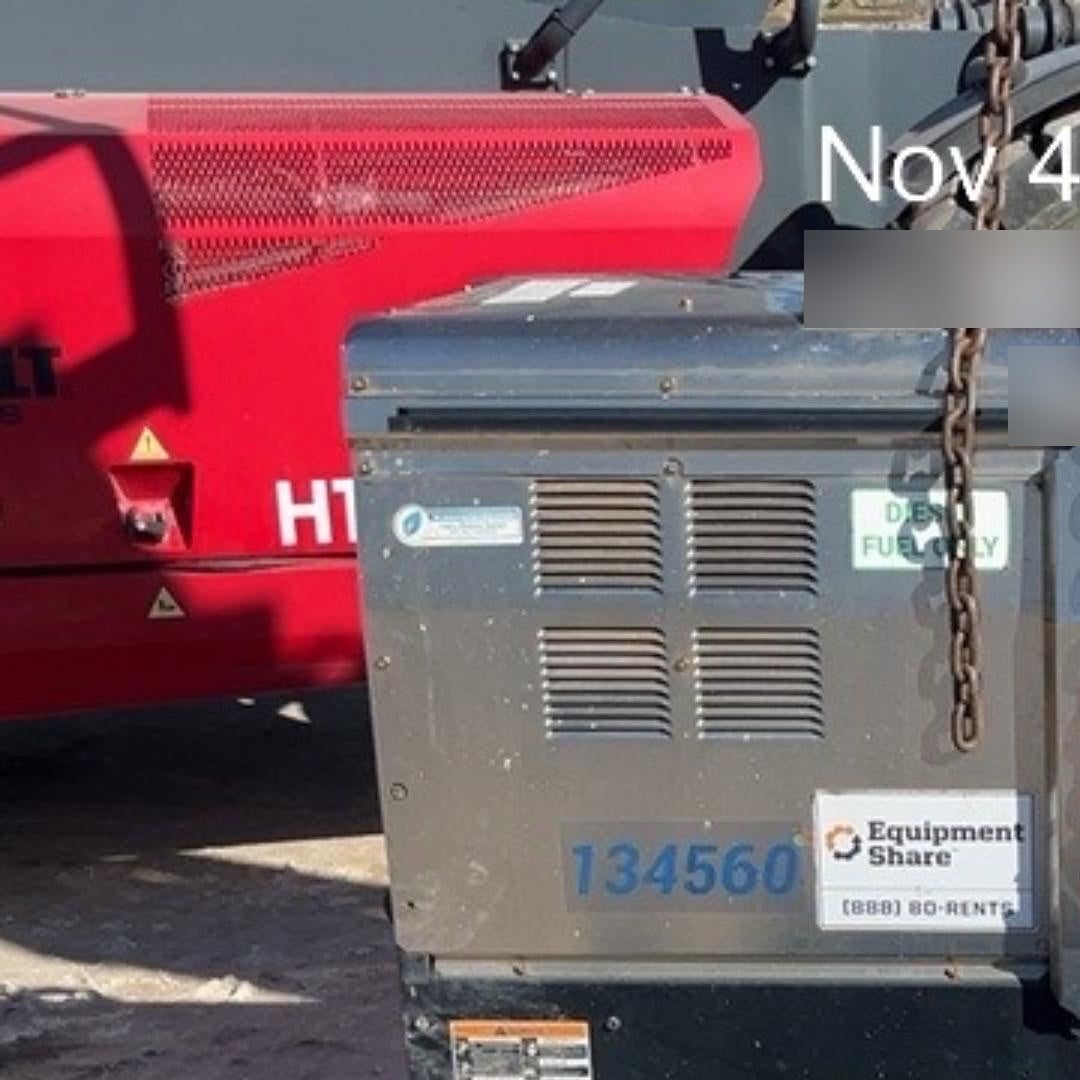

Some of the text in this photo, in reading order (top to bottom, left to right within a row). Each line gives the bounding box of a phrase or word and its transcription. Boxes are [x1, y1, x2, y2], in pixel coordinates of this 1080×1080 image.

[863, 535, 1000, 557] FUEL OLY
[867, 821, 1025, 846] Equipment
[868, 846, 952, 867] Share
[571, 841, 799, 896] 134560
